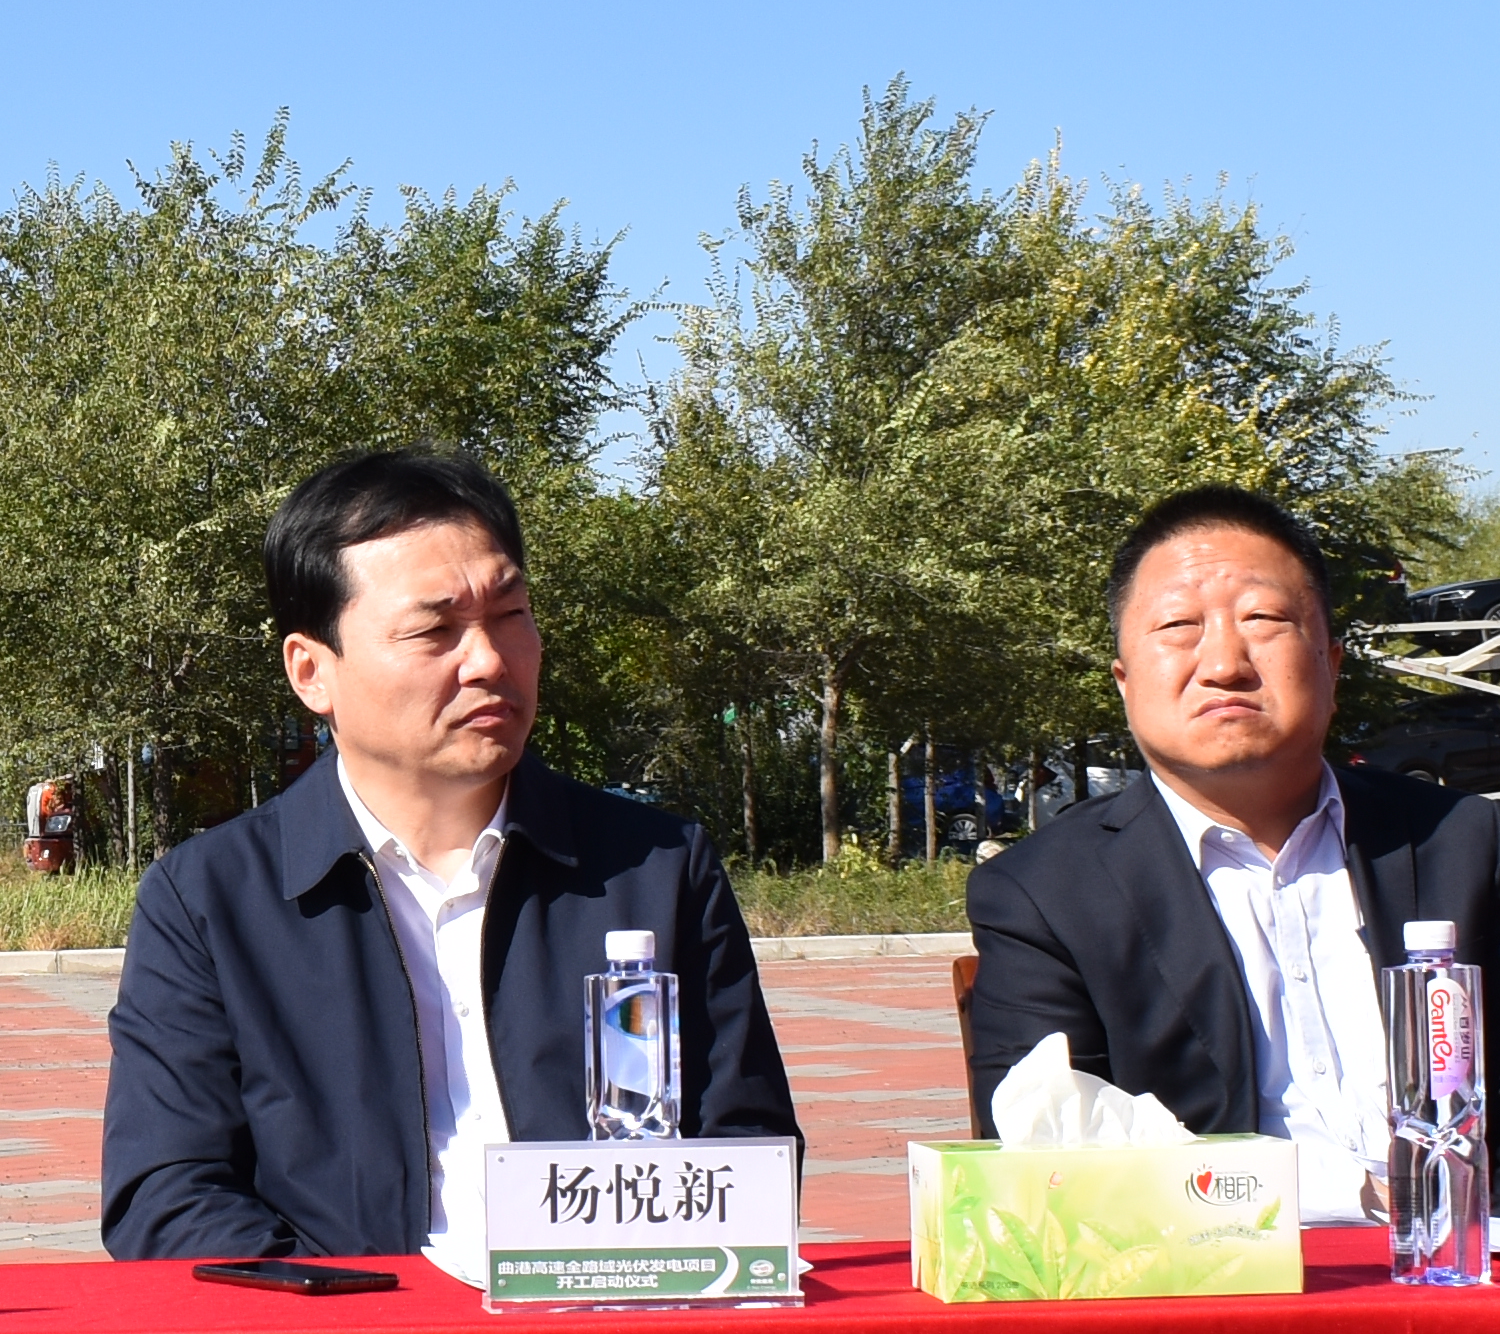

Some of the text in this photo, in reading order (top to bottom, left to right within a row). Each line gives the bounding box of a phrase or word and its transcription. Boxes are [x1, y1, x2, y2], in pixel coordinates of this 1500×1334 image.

[539, 1161, 735, 1224] 杨悦新
[497, 1258, 716, 1275] 曲港高速全路域光伏发电项目
[556, 1274, 659, 1289] 开工启动仪式
